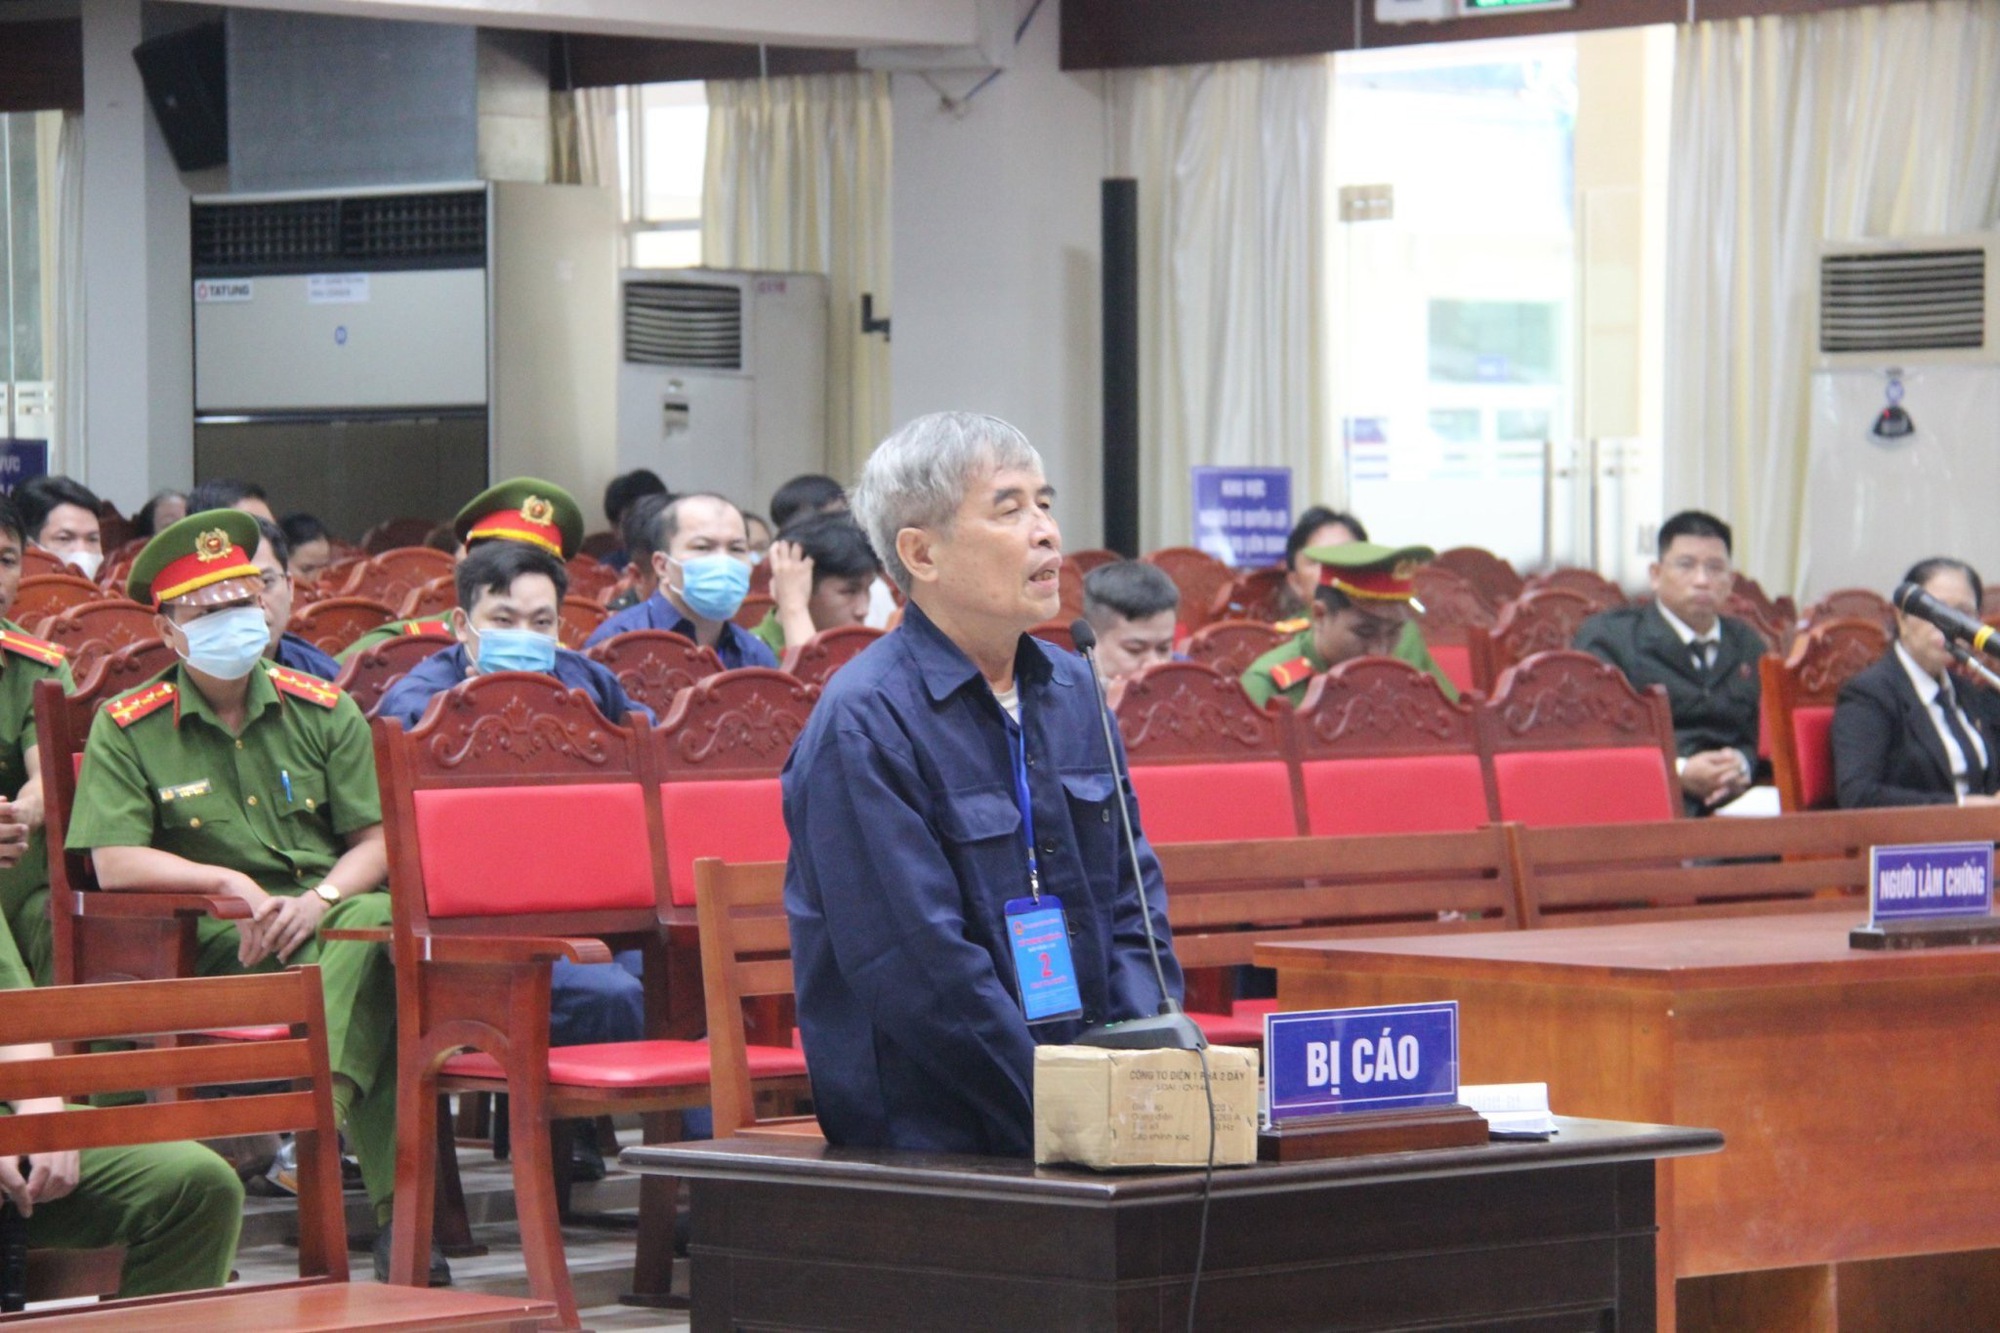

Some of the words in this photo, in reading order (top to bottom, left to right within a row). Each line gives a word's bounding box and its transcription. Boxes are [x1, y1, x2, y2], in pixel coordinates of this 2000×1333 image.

[209, 284, 250, 297] TATUNG
[1880, 861, 1916, 900] NGƯỜI
[1918, 862, 1944, 898] LÀM
[1945, 858, 1985, 898] CHỨNG
[1039, 951, 1054, 978] 2
[1306, 1040, 1341, 1095] BỊ
[1352, 1027, 1420, 1084] CÁO
[1130, 1069, 1154, 1081] CÔNG
